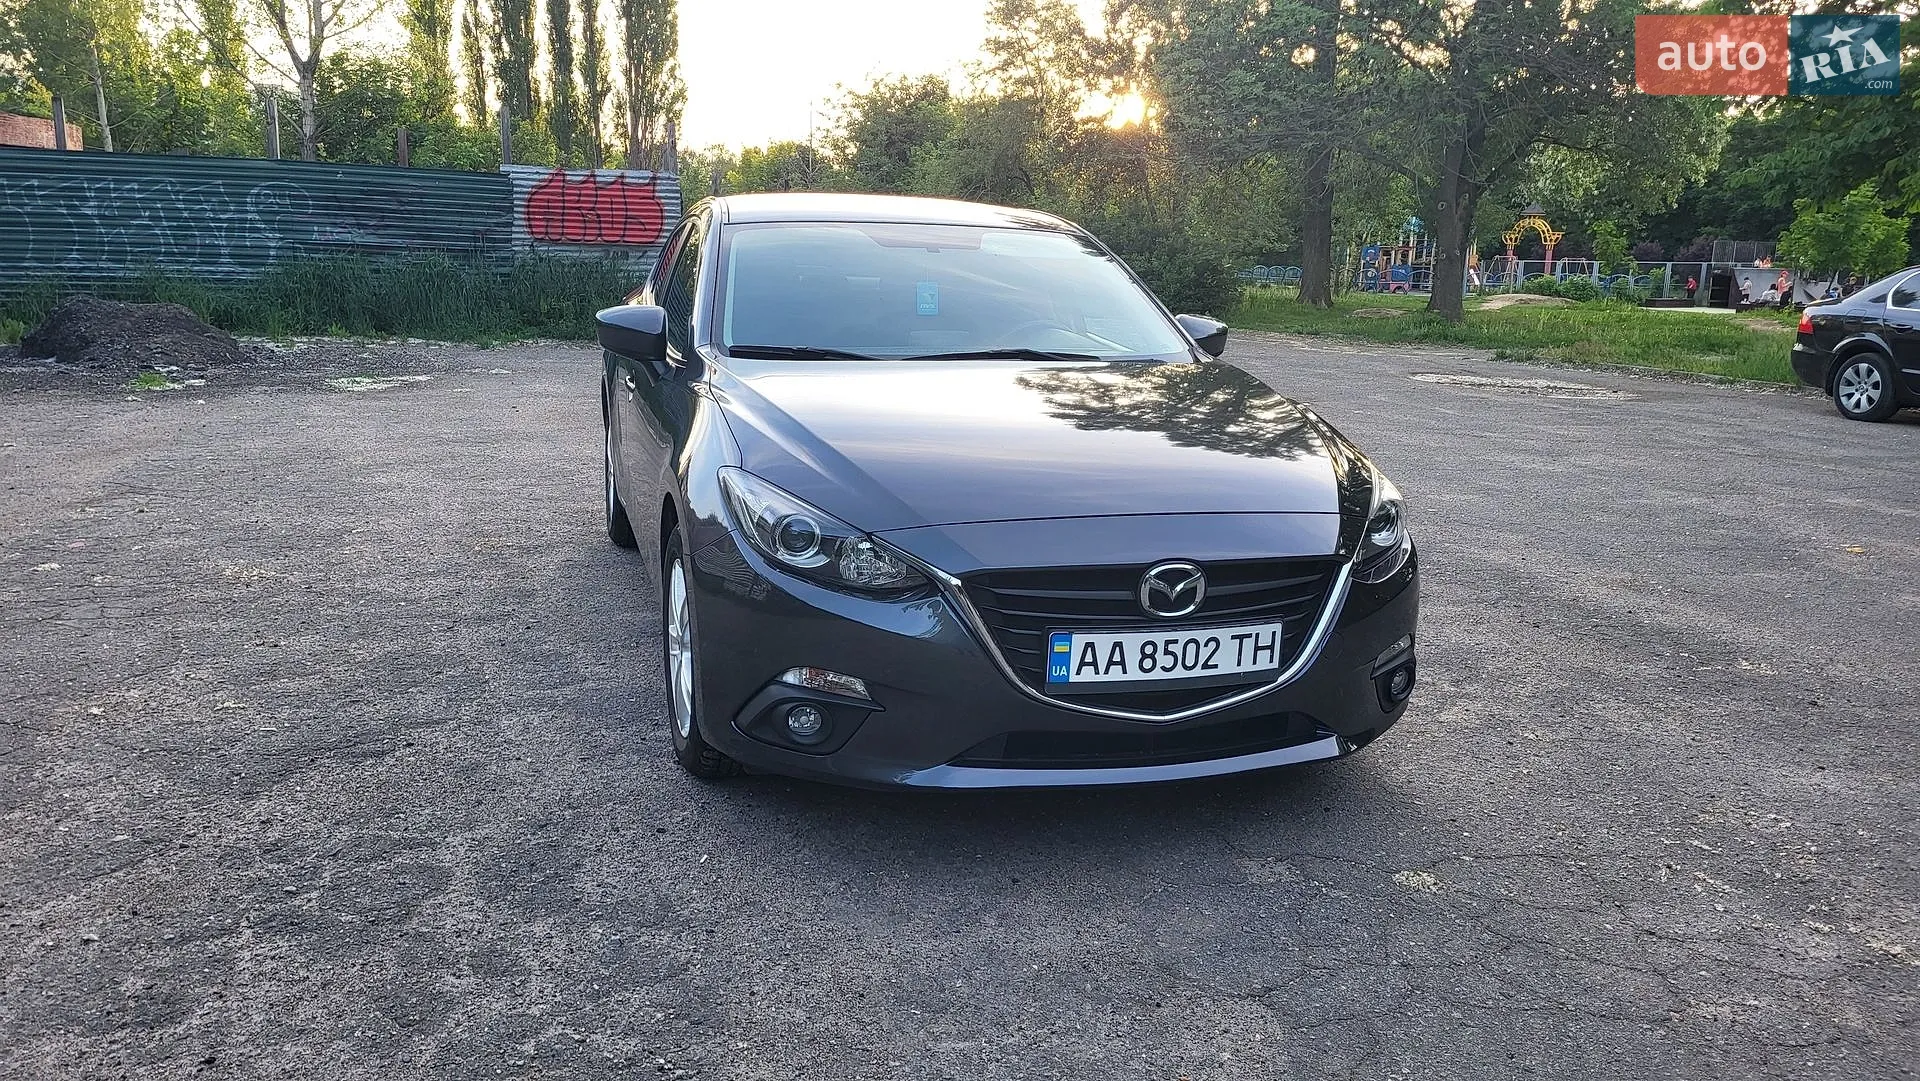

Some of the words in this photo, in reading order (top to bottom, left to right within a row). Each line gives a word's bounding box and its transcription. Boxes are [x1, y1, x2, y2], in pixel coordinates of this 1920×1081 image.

[1075, 641, 1128, 676] AA
[1137, 637, 1221, 674] 8502
[1230, 630, 1277, 667] TH
[1052, 665, 1068, 676] UA
